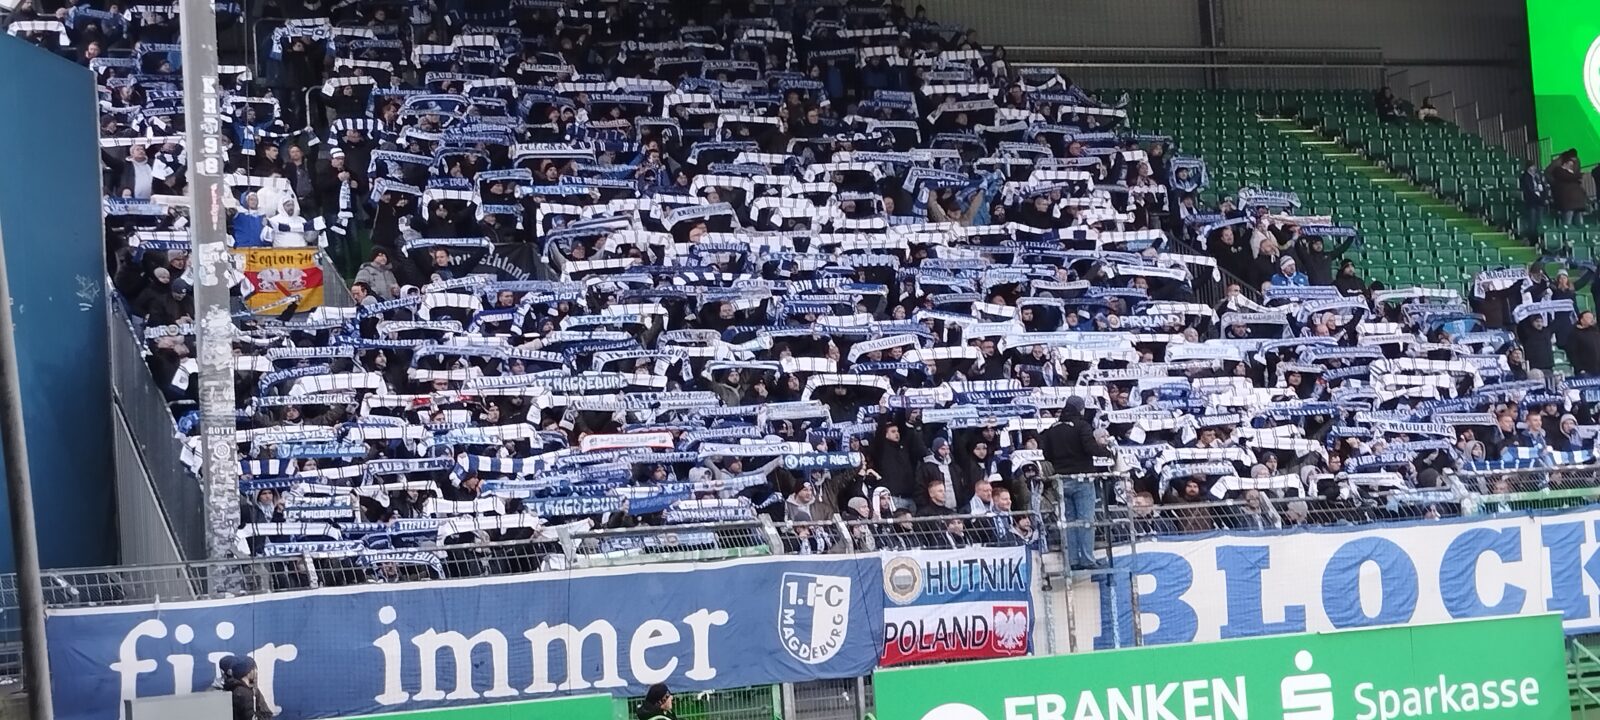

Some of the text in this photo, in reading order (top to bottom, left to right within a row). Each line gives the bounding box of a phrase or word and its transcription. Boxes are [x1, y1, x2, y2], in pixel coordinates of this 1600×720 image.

[250, 252, 294, 267] Legion
[545, 497, 624, 516] MAGDEBUR
[926, 556, 1027, 595] HUTNIK
[373, 605, 729, 706] immer
[782, 609, 845, 661] MAGDEBURG
[881, 616, 989, 660] POLAND
[1003, 673, 1540, 720] FRANKEN Sparkasse
